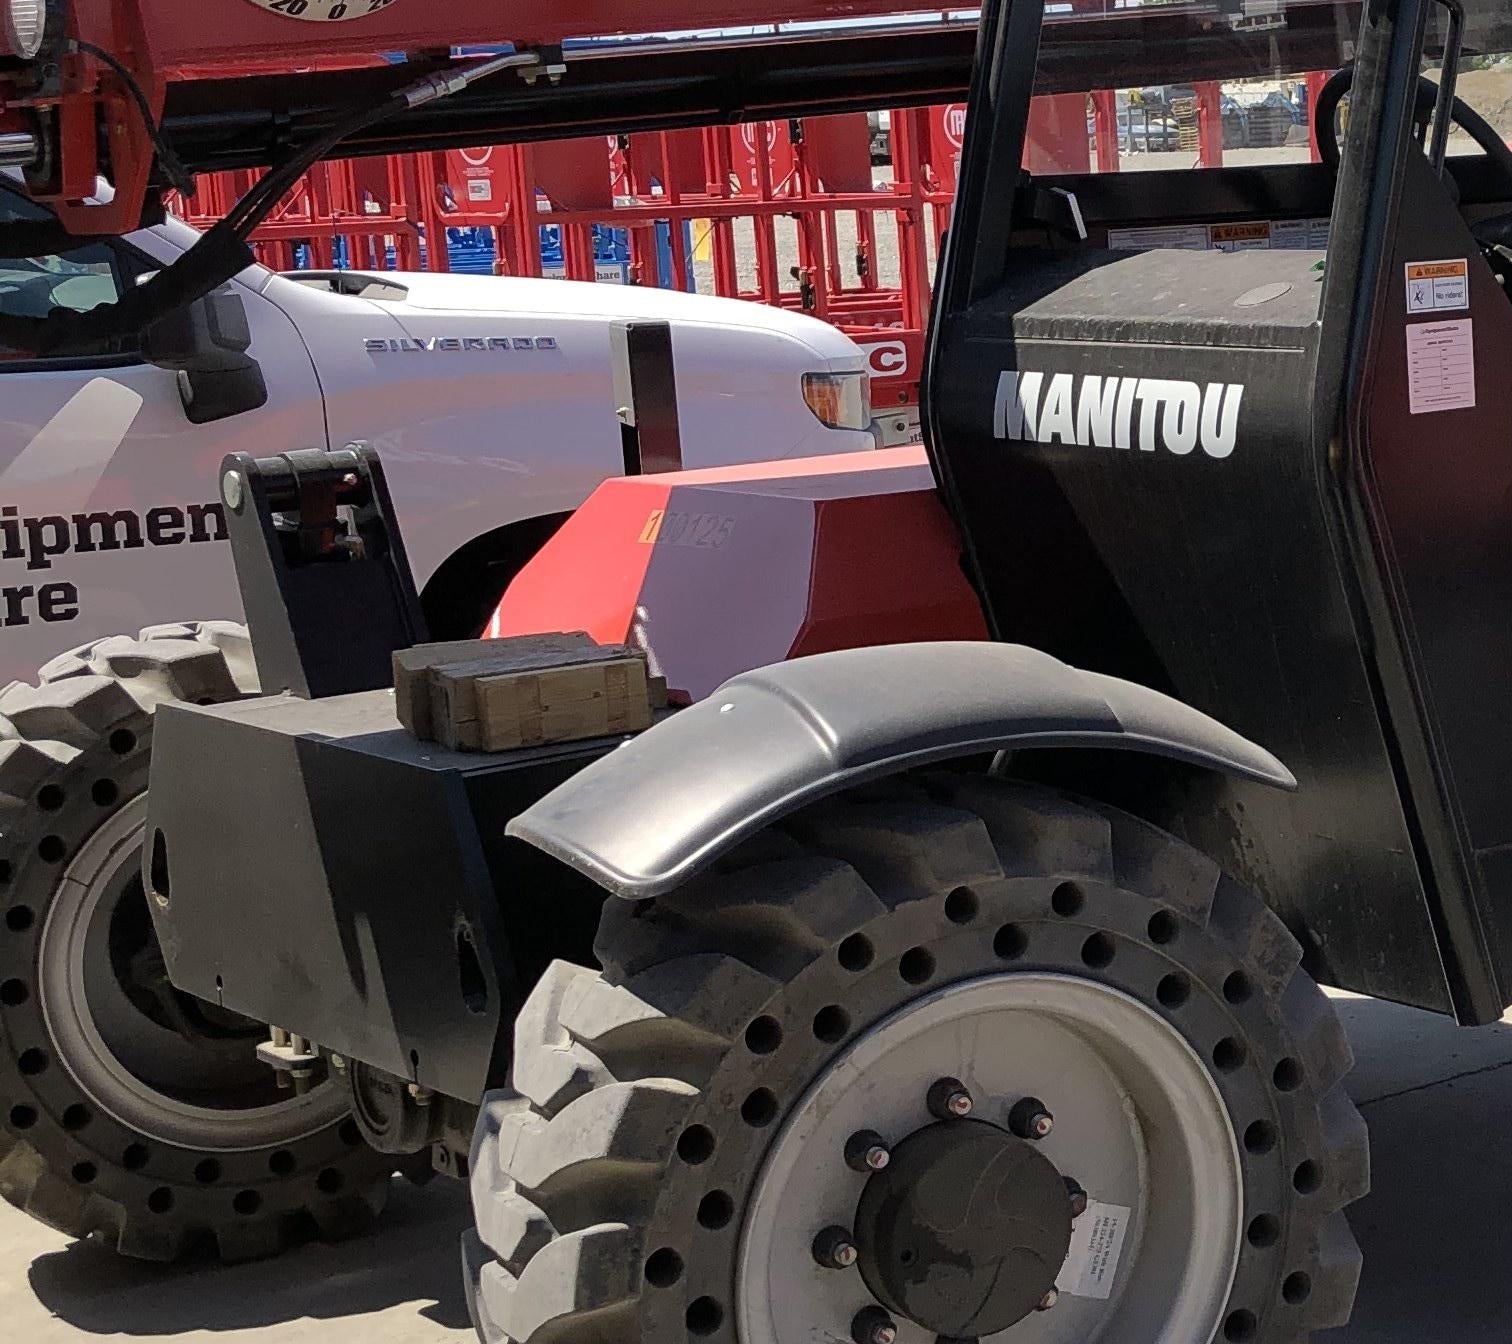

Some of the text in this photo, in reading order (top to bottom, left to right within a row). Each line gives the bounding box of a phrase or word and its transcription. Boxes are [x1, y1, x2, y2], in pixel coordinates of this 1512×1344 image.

[328, 4, 347, 19] 0
[596, 272, 620, 281] hare
[364, 336, 558, 352] SILVERADO
[994, 371, 1244, 458] MANITOU
